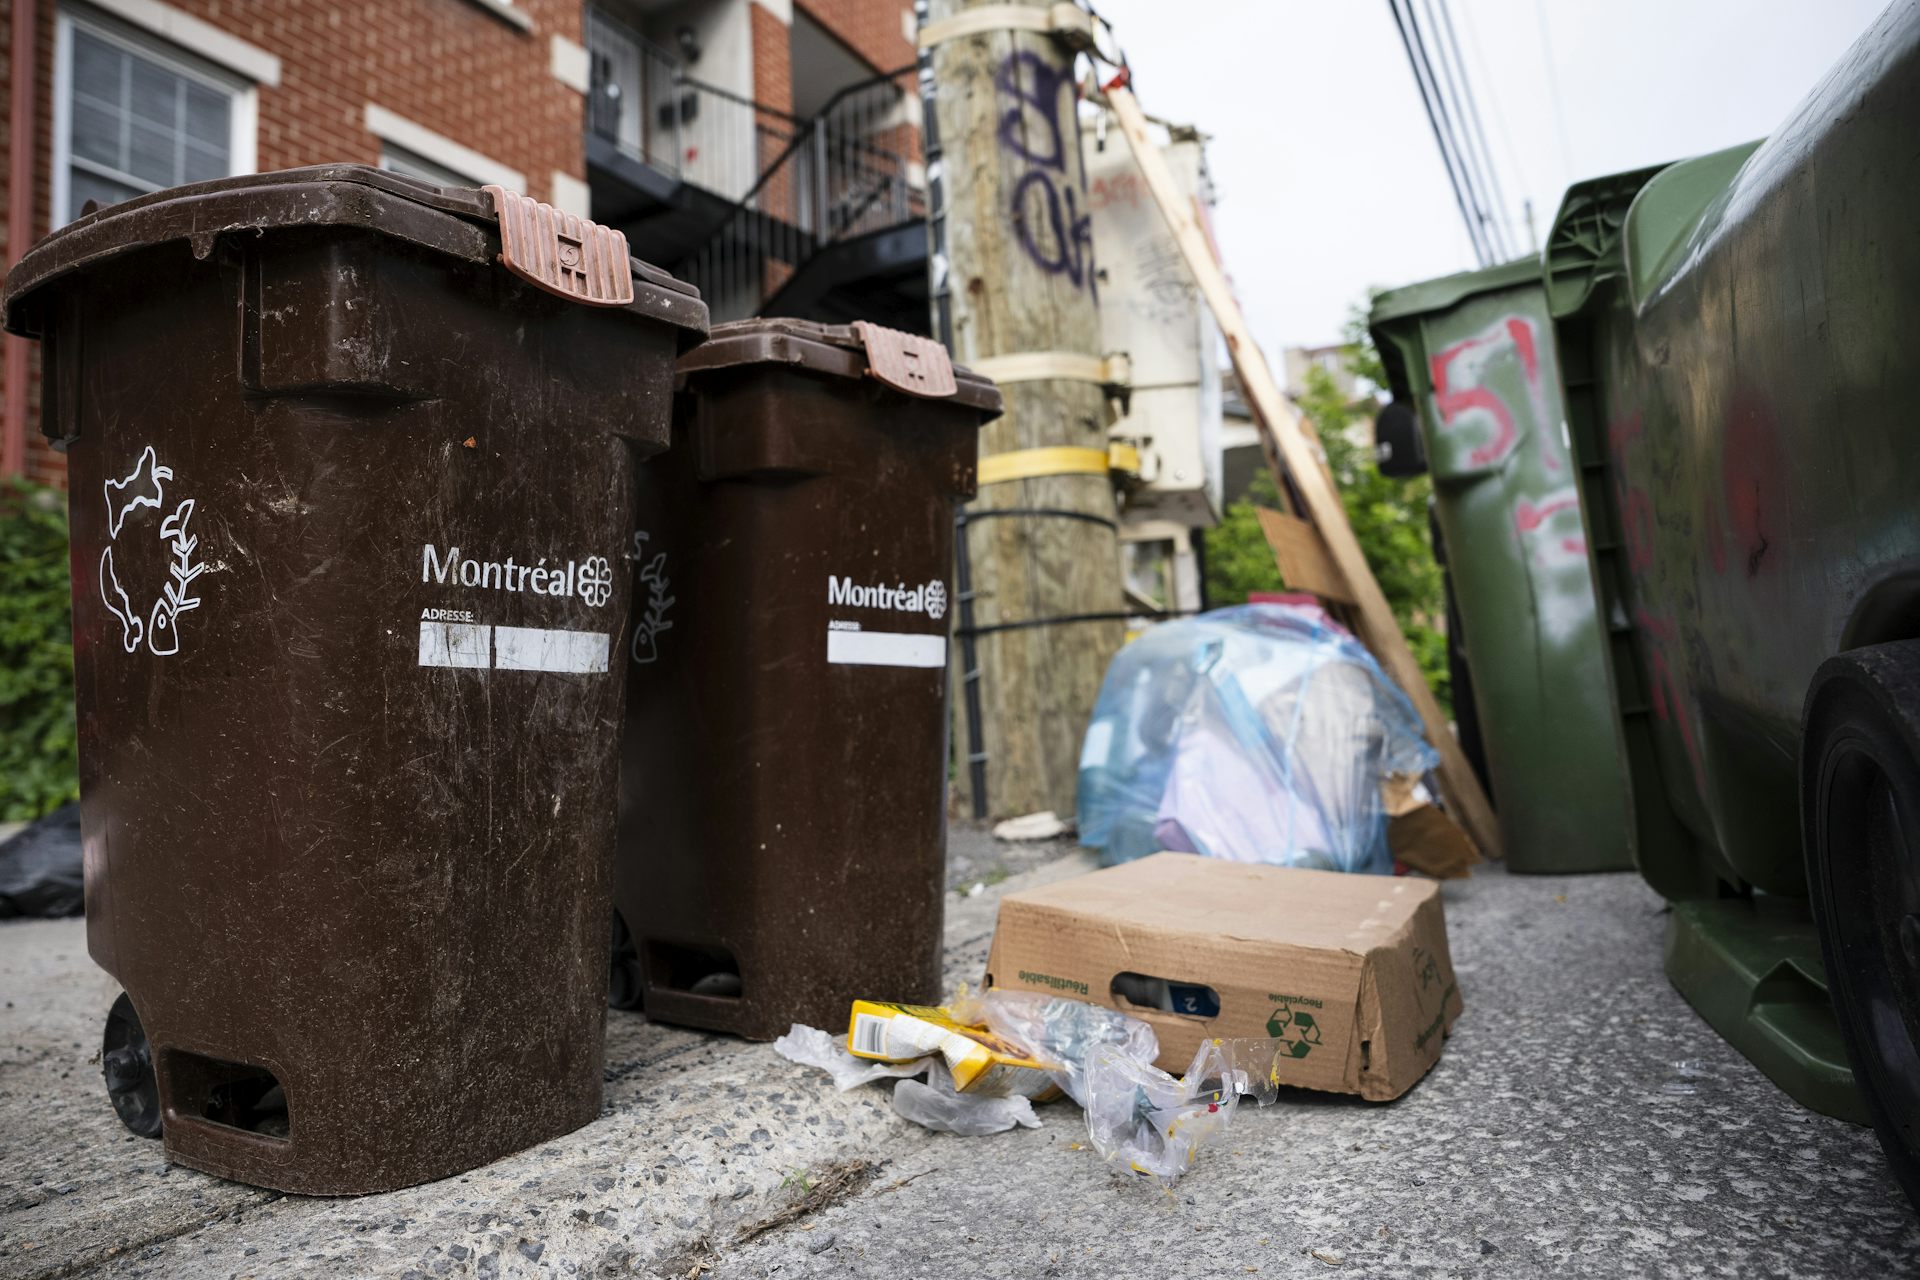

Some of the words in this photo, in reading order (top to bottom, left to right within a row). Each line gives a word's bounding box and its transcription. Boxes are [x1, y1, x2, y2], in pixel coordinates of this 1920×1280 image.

[422, 544, 575, 597] Montréal
[828, 575, 924, 612] Montréal
[421, 608, 474, 622] ADRESSE:
[1018, 970, 1089, 995] Réutilisable
[1268, 993, 1323, 1009] Recyclable
